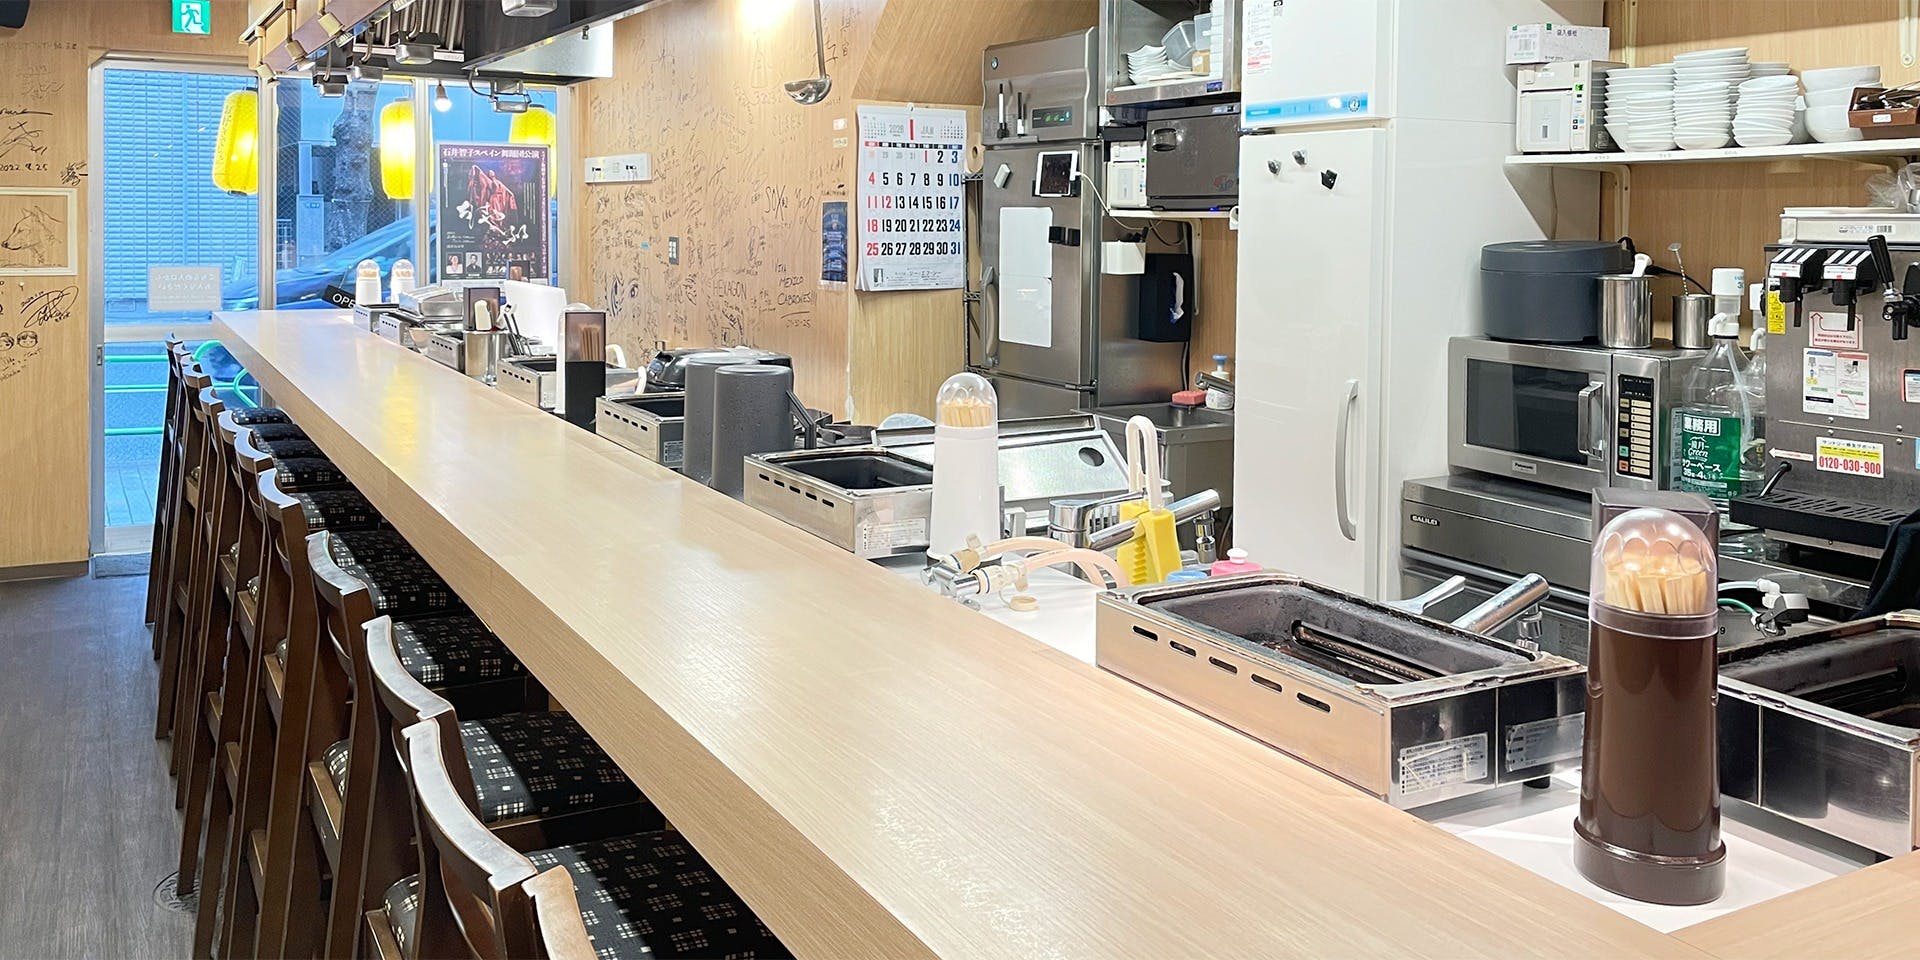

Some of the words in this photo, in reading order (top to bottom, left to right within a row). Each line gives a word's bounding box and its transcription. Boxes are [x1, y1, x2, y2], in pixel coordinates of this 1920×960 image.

[924, 150, 928, 163] 1
[937, 150, 944, 163] 2
[951, 150, 958, 163] 3
[868, 171, 875, 185] 4
[882, 172, 889, 186] 5
[896, 172, 903, 186] 6
[910, 173, 916, 186] 7
[923, 173, 930, 187] 8
[937, 173, 944, 187] 9
[949, 173, 959, 187] 10
[867, 195, 878, 209] 11
[881, 195, 892, 209] 12
[895, 195, 905, 209] 13
[908, 196, 919, 209] 14
[922, 196, 932, 210] 15
[936, 196, 946, 210] 16
[949, 196, 960, 210] 17
[867, 219, 878, 232] 18
[882, 219, 892, 232] 19
[895, 219, 907, 232] 20
[909, 219, 920, 232] 21
[922, 219, 934, 232] 22
[936, 219, 948, 232] 23
[949, 218, 961, 232] 24
[866, 242, 879, 256] 25
[881, 242, 893, 256] 26
[895, 242, 907, 256] 27
[909, 242, 920, 256] 28
[923, 241, 934, 256] 29
[936, 241, 948, 255] 30
[950, 241, 961, 255] 31
[712, 280, 747, 300] HEXAGON
[332, 293, 356, 308] OPE
[1683, 416, 1718, 433] 業務用
[1819, 455, 1881, 475] 0120-030-900
